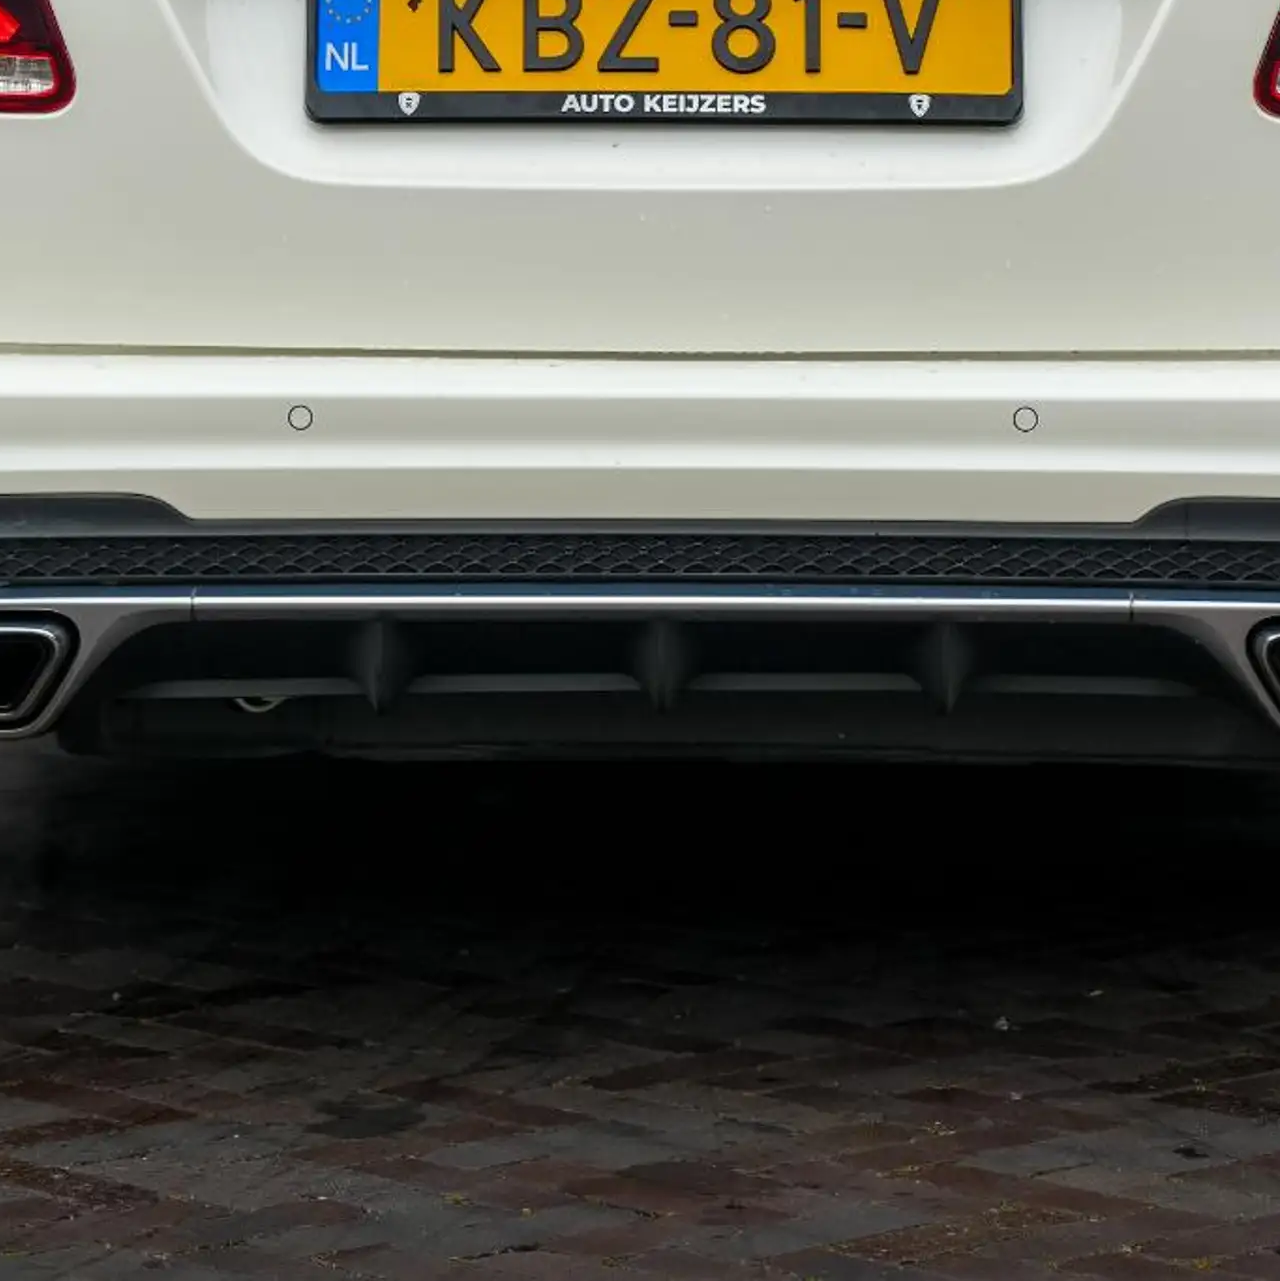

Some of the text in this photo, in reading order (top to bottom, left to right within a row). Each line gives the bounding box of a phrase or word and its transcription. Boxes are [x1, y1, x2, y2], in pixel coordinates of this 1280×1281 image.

[325, 41, 370, 71] NL
[561, 93, 767, 114] AUTO KEIJZERS
